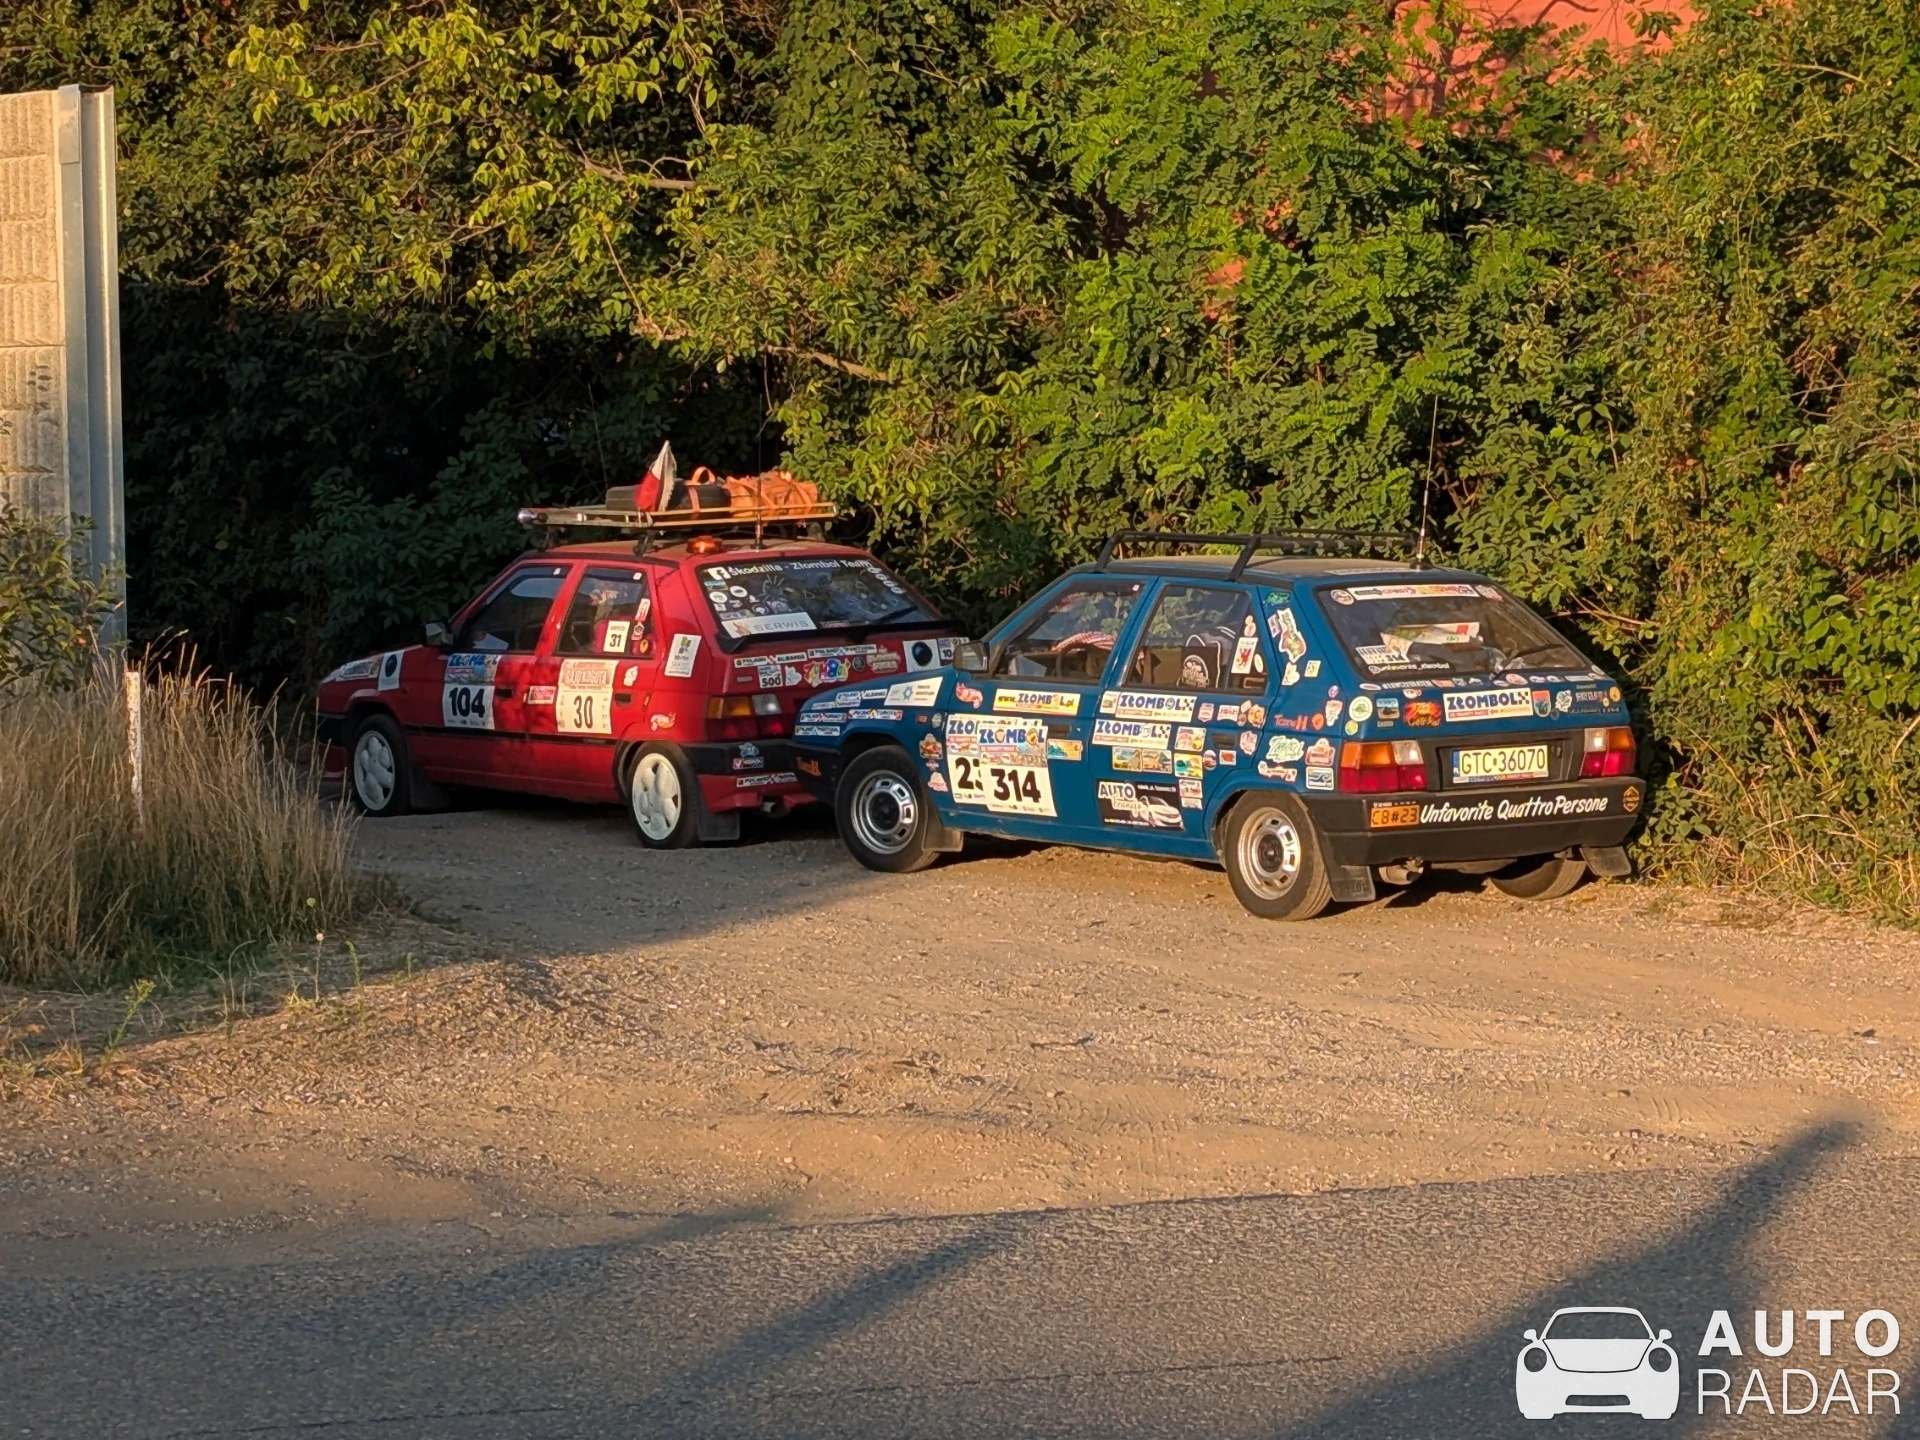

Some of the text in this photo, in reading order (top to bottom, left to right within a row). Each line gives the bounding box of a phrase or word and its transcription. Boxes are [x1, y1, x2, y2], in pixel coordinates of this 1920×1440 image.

[840, 559, 873, 569] Team
[752, 620, 809, 632] SERWIS
[609, 633, 622, 648] 31
[449, 687, 485, 718] 104
[1120, 694, 1181, 711] ZŁOMBOL
[1447, 692, 1518, 710] ZŁOMBOL
[573, 695, 593, 729] 30
[1096, 720, 1158, 738] ZŁOMBOL
[1461, 748, 1546, 775] GTC 36070
[990, 768, 1041, 803] 314
[1100, 783, 1134, 799] AUTO
[1421, 800, 1494, 823] Unfavorite
